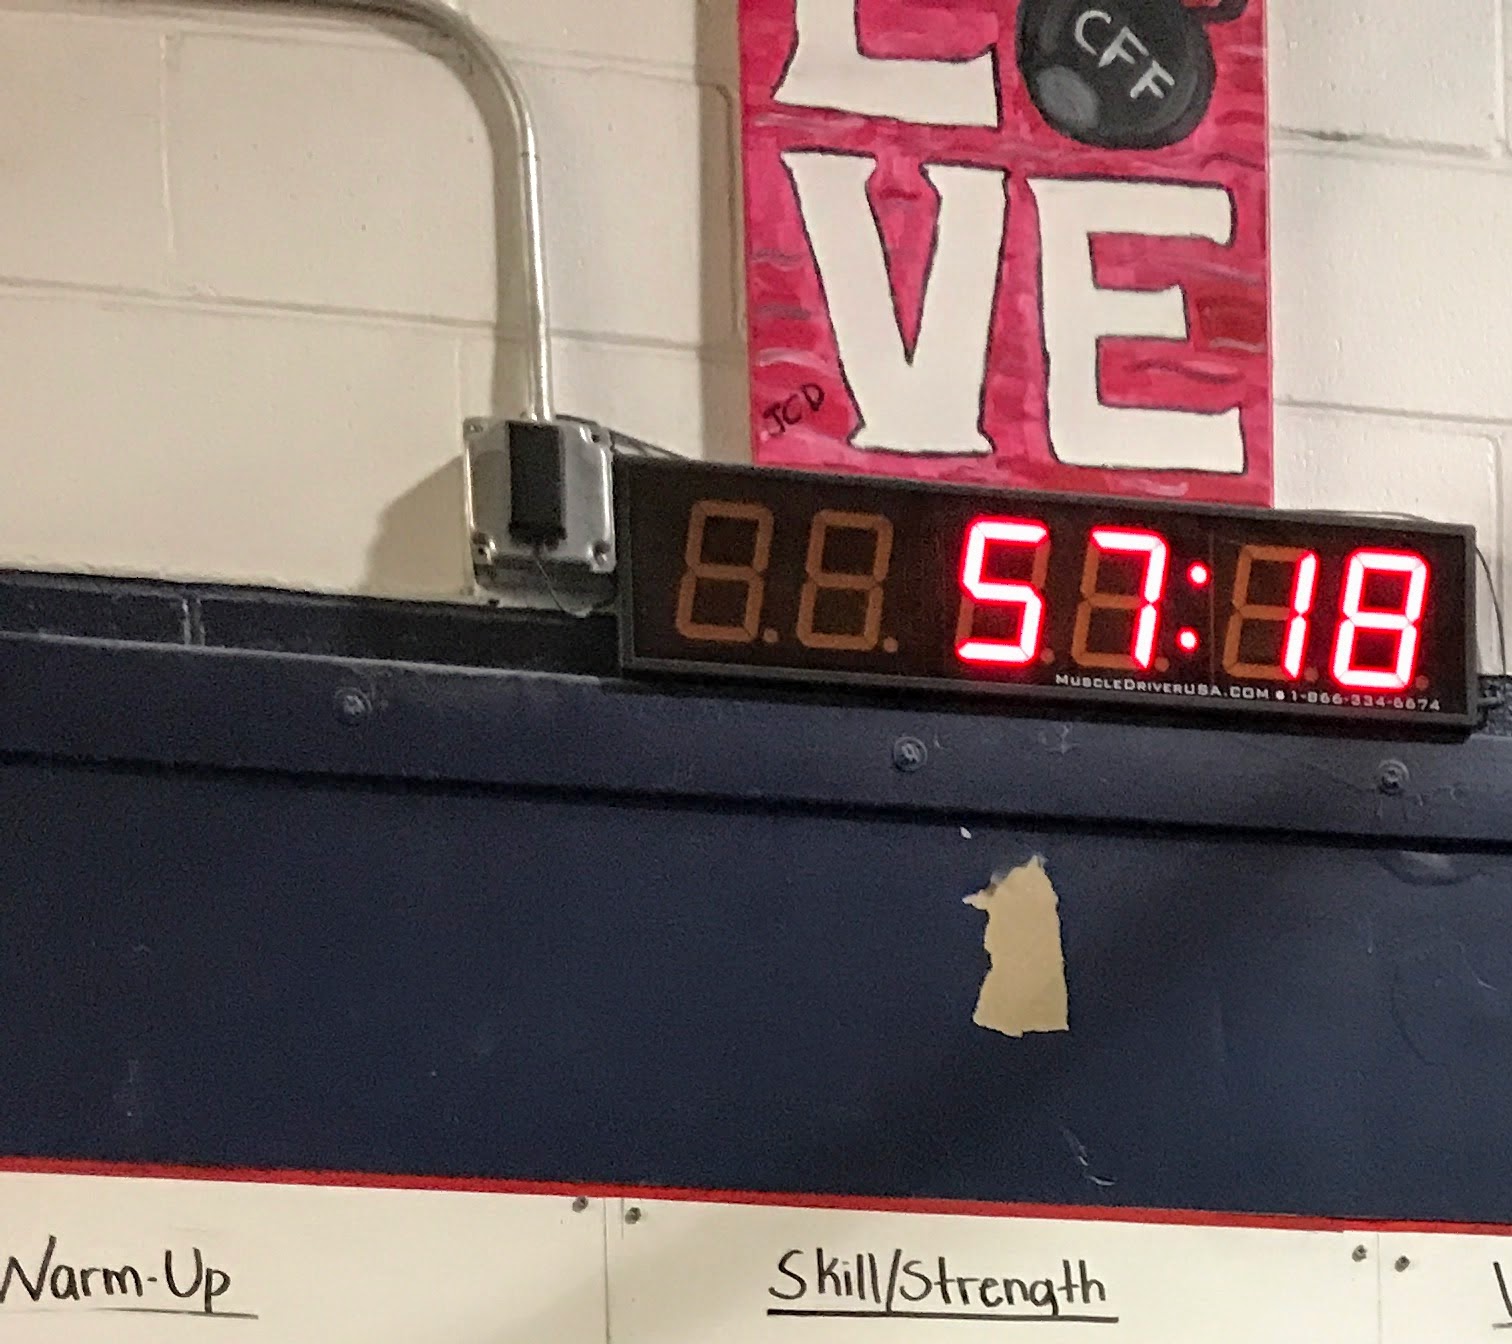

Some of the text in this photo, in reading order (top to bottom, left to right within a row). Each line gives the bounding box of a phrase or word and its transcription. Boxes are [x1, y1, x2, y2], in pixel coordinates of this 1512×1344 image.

[1073, 9, 1176, 99] CFF
[762, 383, 826, 437] JCD
[954, 515, 1430, 691] 57:18
[768, 1248, 1107, 1316] Skill/Strength
